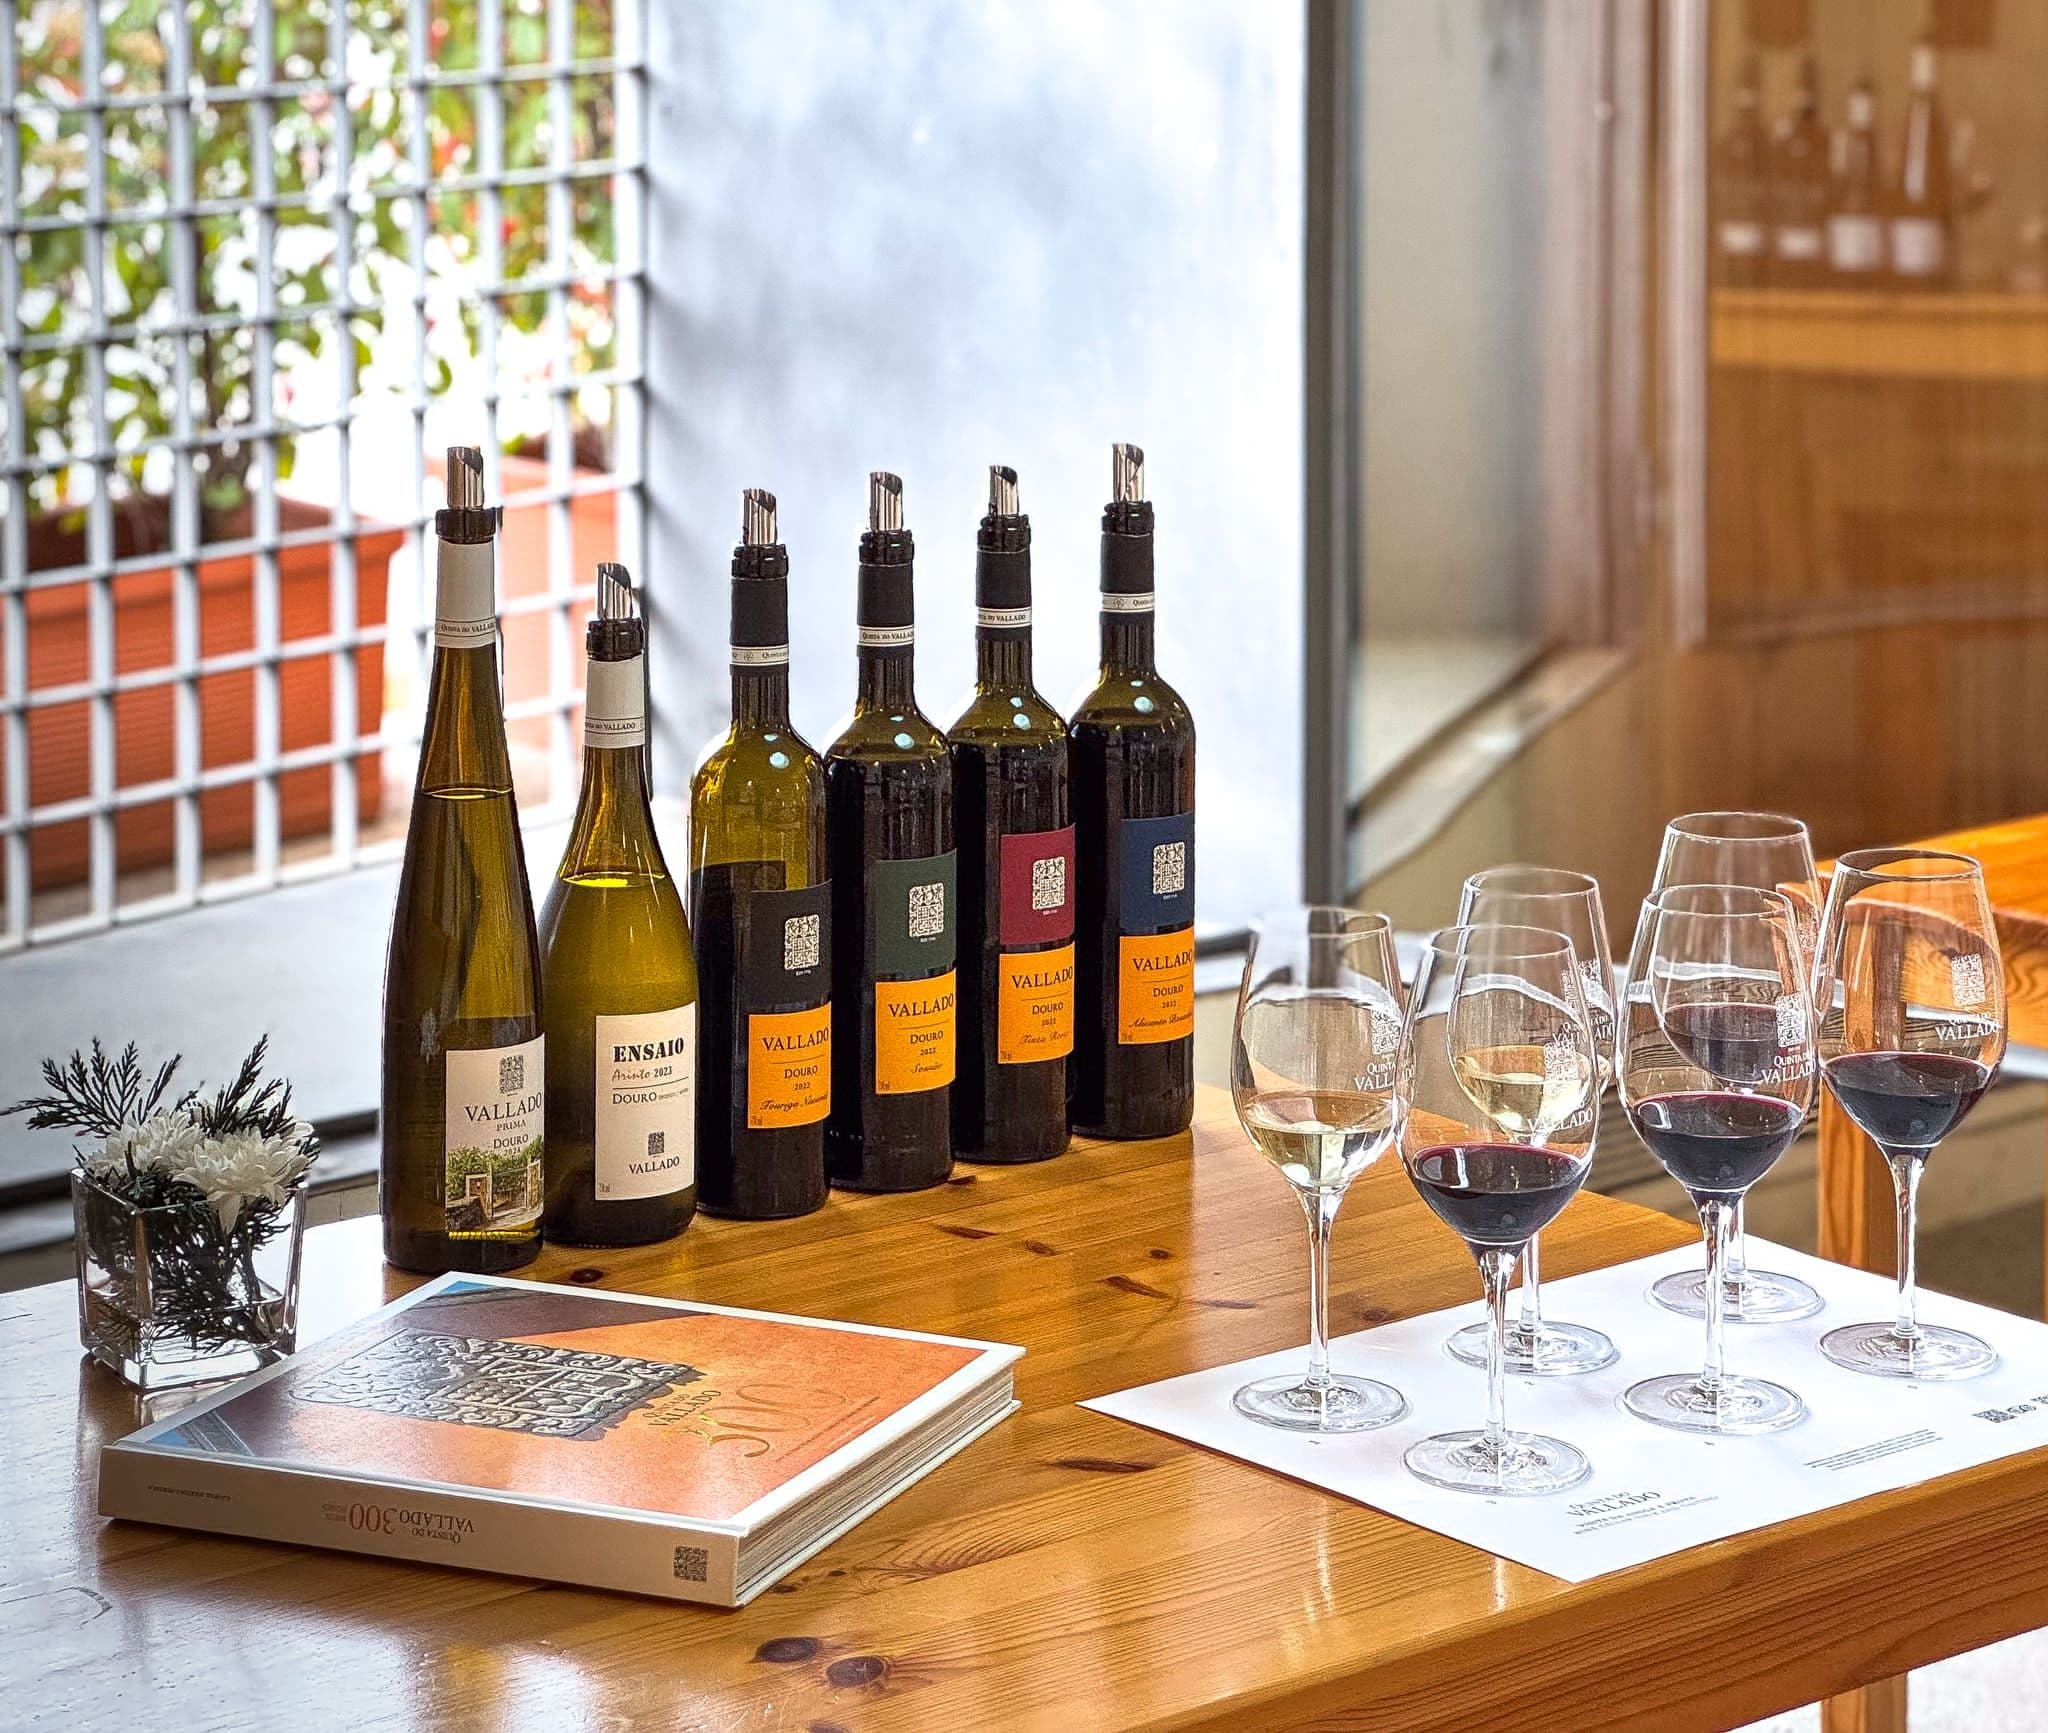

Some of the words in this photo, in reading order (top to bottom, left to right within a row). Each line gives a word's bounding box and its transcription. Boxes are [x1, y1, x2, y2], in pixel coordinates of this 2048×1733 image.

[603, 722, 635, 730] VALLADO
[1011, 966, 1073, 989] VALLADO
[1153, 984, 1184, 997] DOURO
[888, 993, 954, 1017] VALLADO
[1032, 1002, 1064, 1015] DOURO
[762, 1026, 829, 1051] VALLADO
[910, 1030, 943, 1044] DOURO
[1935, 1020, 1999, 1041] VALLADO
[613, 1037, 684, 1062] ENSAIO
[612, 1068, 650, 1082] Arinto
[653, 1065, 672, 1078] 2023
[784, 1064, 818, 1079] DOURO
[1367, 1061, 1396, 1074] QUINTA
[1761, 1057, 1816, 1083] VALLADO
[464, 1091, 542, 1122] VALLADO
[612, 1091, 657, 1105] DOURO
[496, 1119, 526, 1131] PRIMA
[493, 1133, 529, 1149] DOURO
[629, 1156, 680, 1174] VALLADO
[648, 1390, 721, 1426] VALLADO
[1566, 1491, 1661, 1517] VALLADO
[350, 1503, 398, 1535] 300
[400, 1509, 474, 1533] VALLADO
